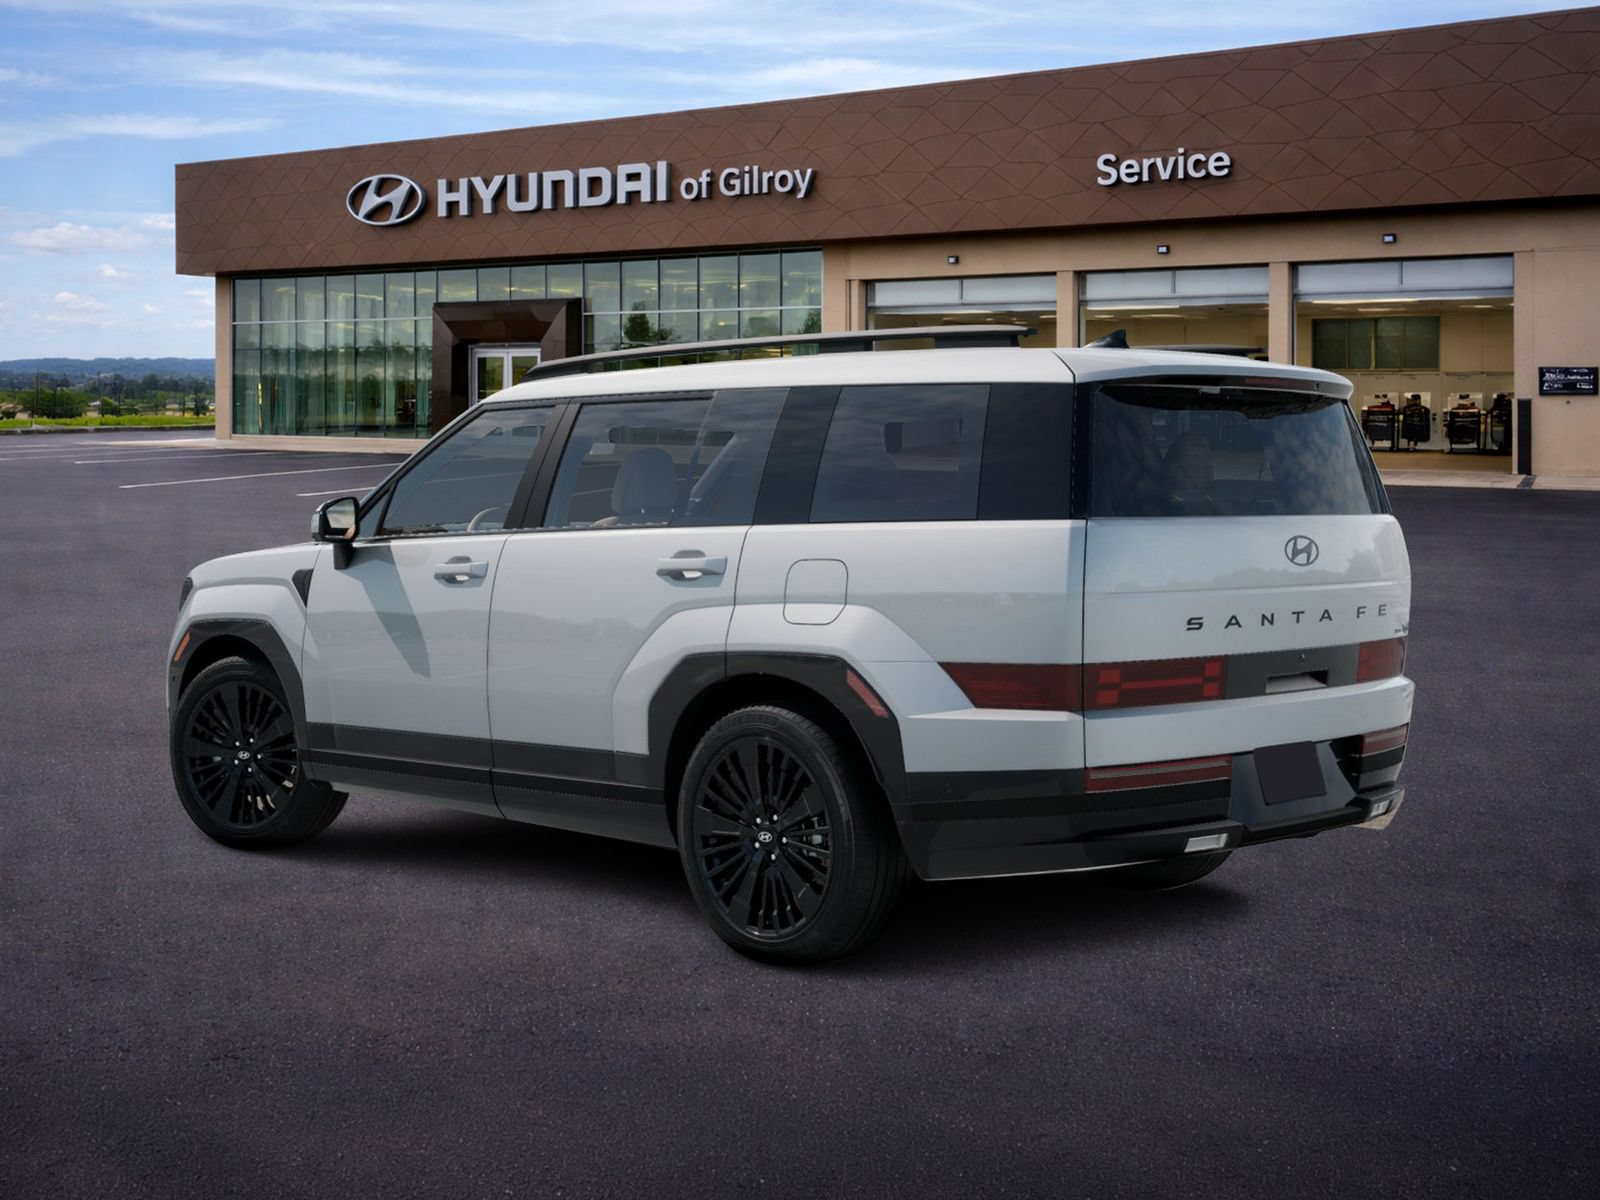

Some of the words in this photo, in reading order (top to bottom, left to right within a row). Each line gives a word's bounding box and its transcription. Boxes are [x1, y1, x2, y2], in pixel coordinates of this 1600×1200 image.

[1096, 147, 1232, 186] Service
[437, 160, 669, 217] HYUNDAI
[680, 168, 712, 200] of
[719, 165, 813, 199] Gilroy
[1185, 609, 1334, 631] SANTA
[1356, 604, 1388, 619] FE
